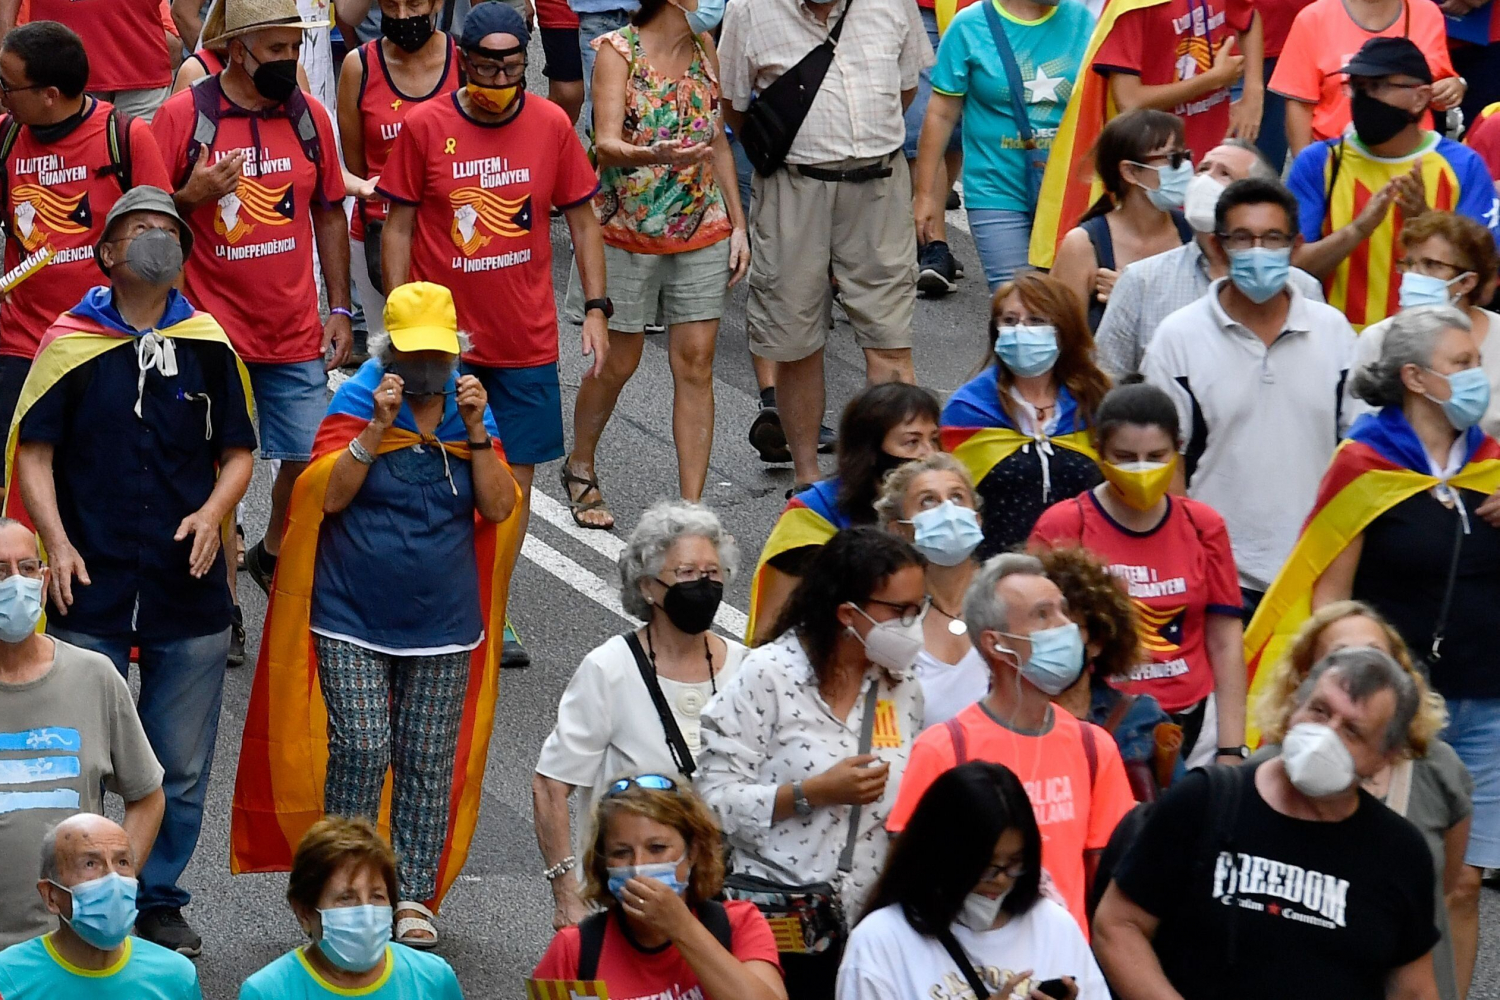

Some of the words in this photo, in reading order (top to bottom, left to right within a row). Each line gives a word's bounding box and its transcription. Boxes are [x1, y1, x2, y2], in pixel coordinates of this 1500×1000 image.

[15, 153, 59, 176] LLUITEM
[37, 165, 88, 187] GUANYEM
[453, 156, 500, 180] LLUITEM
[503, 157, 508, 171] I
[480, 168, 530, 189] GUANYEM
[215, 246, 226, 260] LA
[226, 237, 296, 264] INDEPENDÈNCIA
[452, 256, 463, 270] LA
[463, 248, 532, 273] INDEPENDÈNCIA
[1211, 851, 1351, 930] FREEDOM
